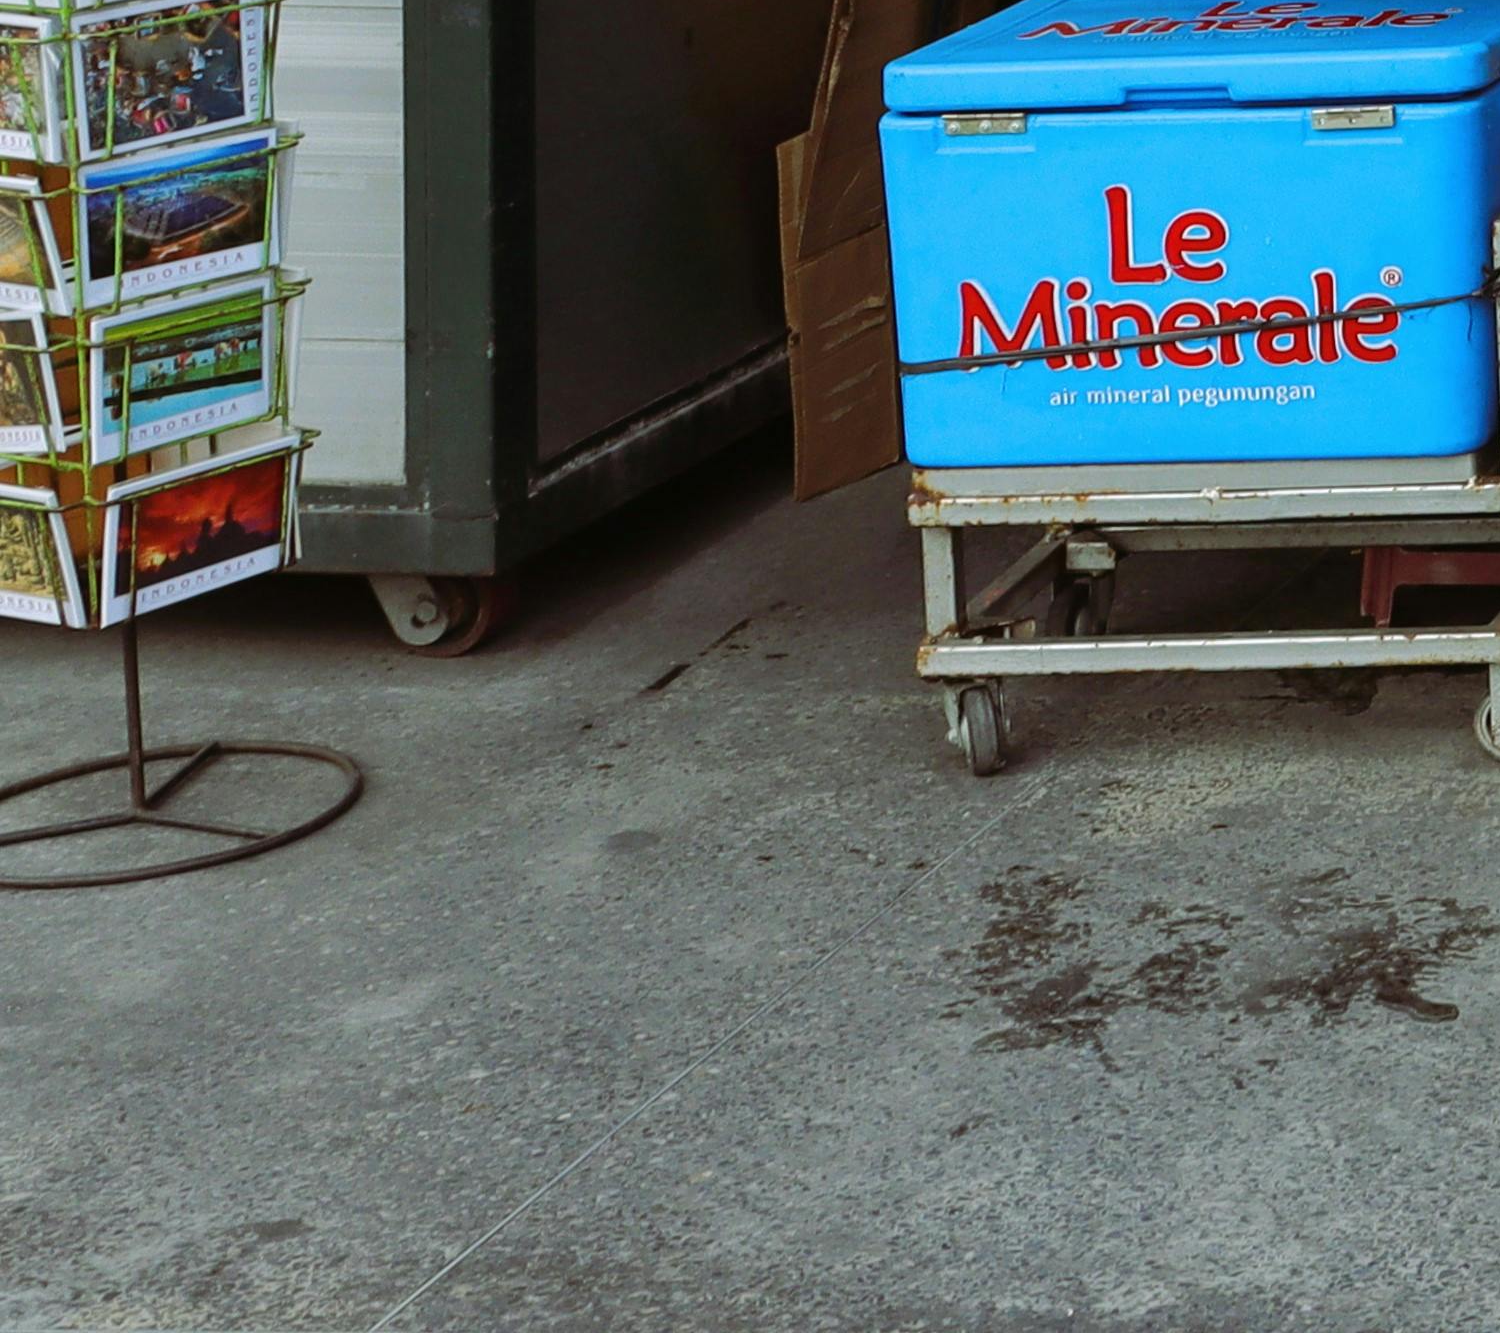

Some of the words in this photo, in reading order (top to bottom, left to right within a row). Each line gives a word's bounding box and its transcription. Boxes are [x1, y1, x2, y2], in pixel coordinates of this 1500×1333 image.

[1018, 9, 1453, 39] Minerale
[1195, 0, 1320, 19] Le
[1104, 184, 1230, 284] Le
[958, 271, 1401, 369] Minerale
[1049, 387, 1078, 407] air
[1086, 384, 1171, 405] mineral
[1178, 382, 1316, 407] pegunungan
[130, 402, 239, 440] INDONESIA
[140, 556, 256, 603] INDONESIA
